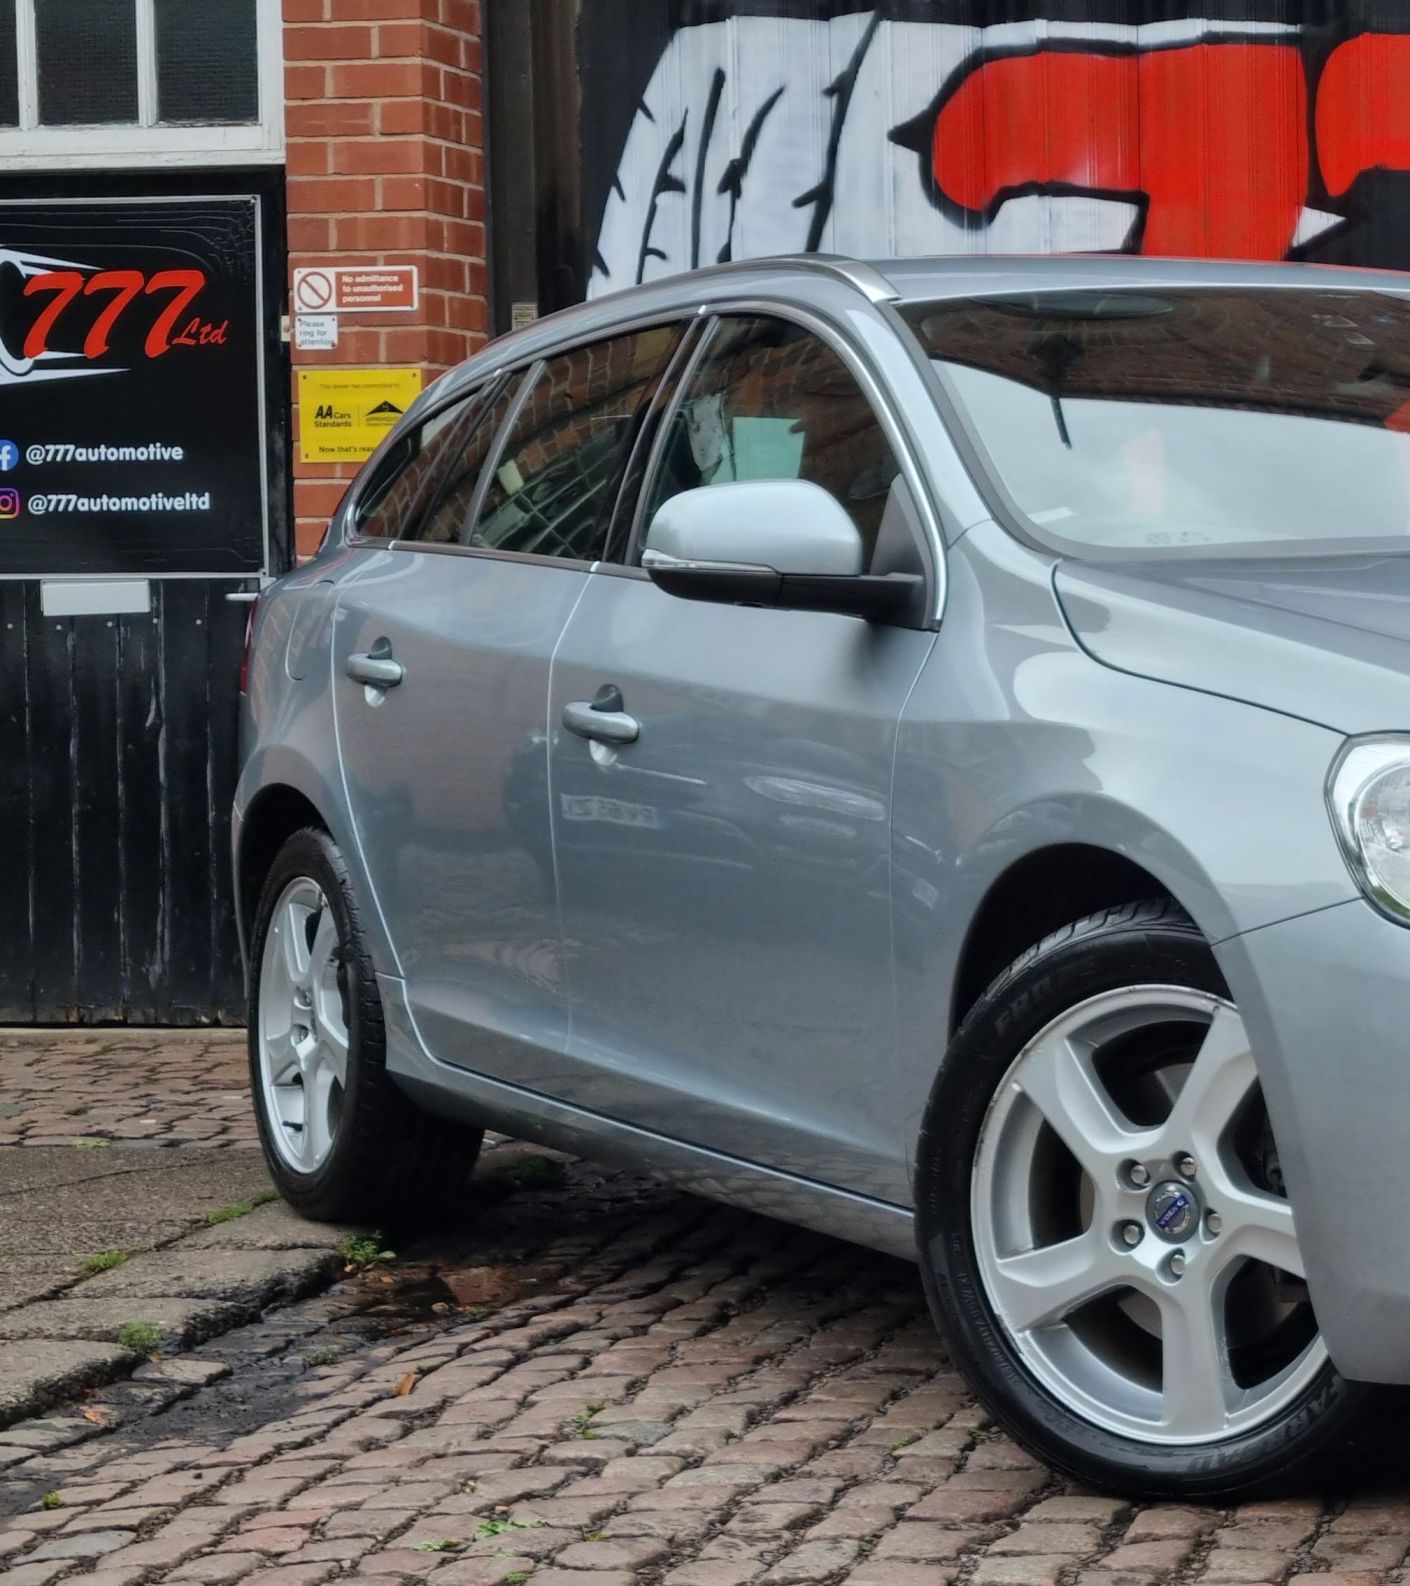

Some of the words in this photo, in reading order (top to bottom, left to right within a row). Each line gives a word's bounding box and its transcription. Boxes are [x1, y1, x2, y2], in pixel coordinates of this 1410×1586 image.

[341, 275, 353, 283] No
[355, 274, 399, 283] admittance
[342, 284, 352, 293] to
[353, 284, 404, 293] unauthorised
[342, 294, 382, 303] personnel
[23, 270, 205, 359] 777
[171, 317, 229, 345] Ltd
[300, 319, 325, 328] Please
[300, 330, 314, 338] ring
[316, 329, 328, 337] for
[315, 405, 332, 419] AA
[314, 420, 352, 428] Standards
[26, 442, 183, 464] @777automotive
[337, 445, 358, 453] that's
[28, 492, 210, 515] @777automotiveltd
